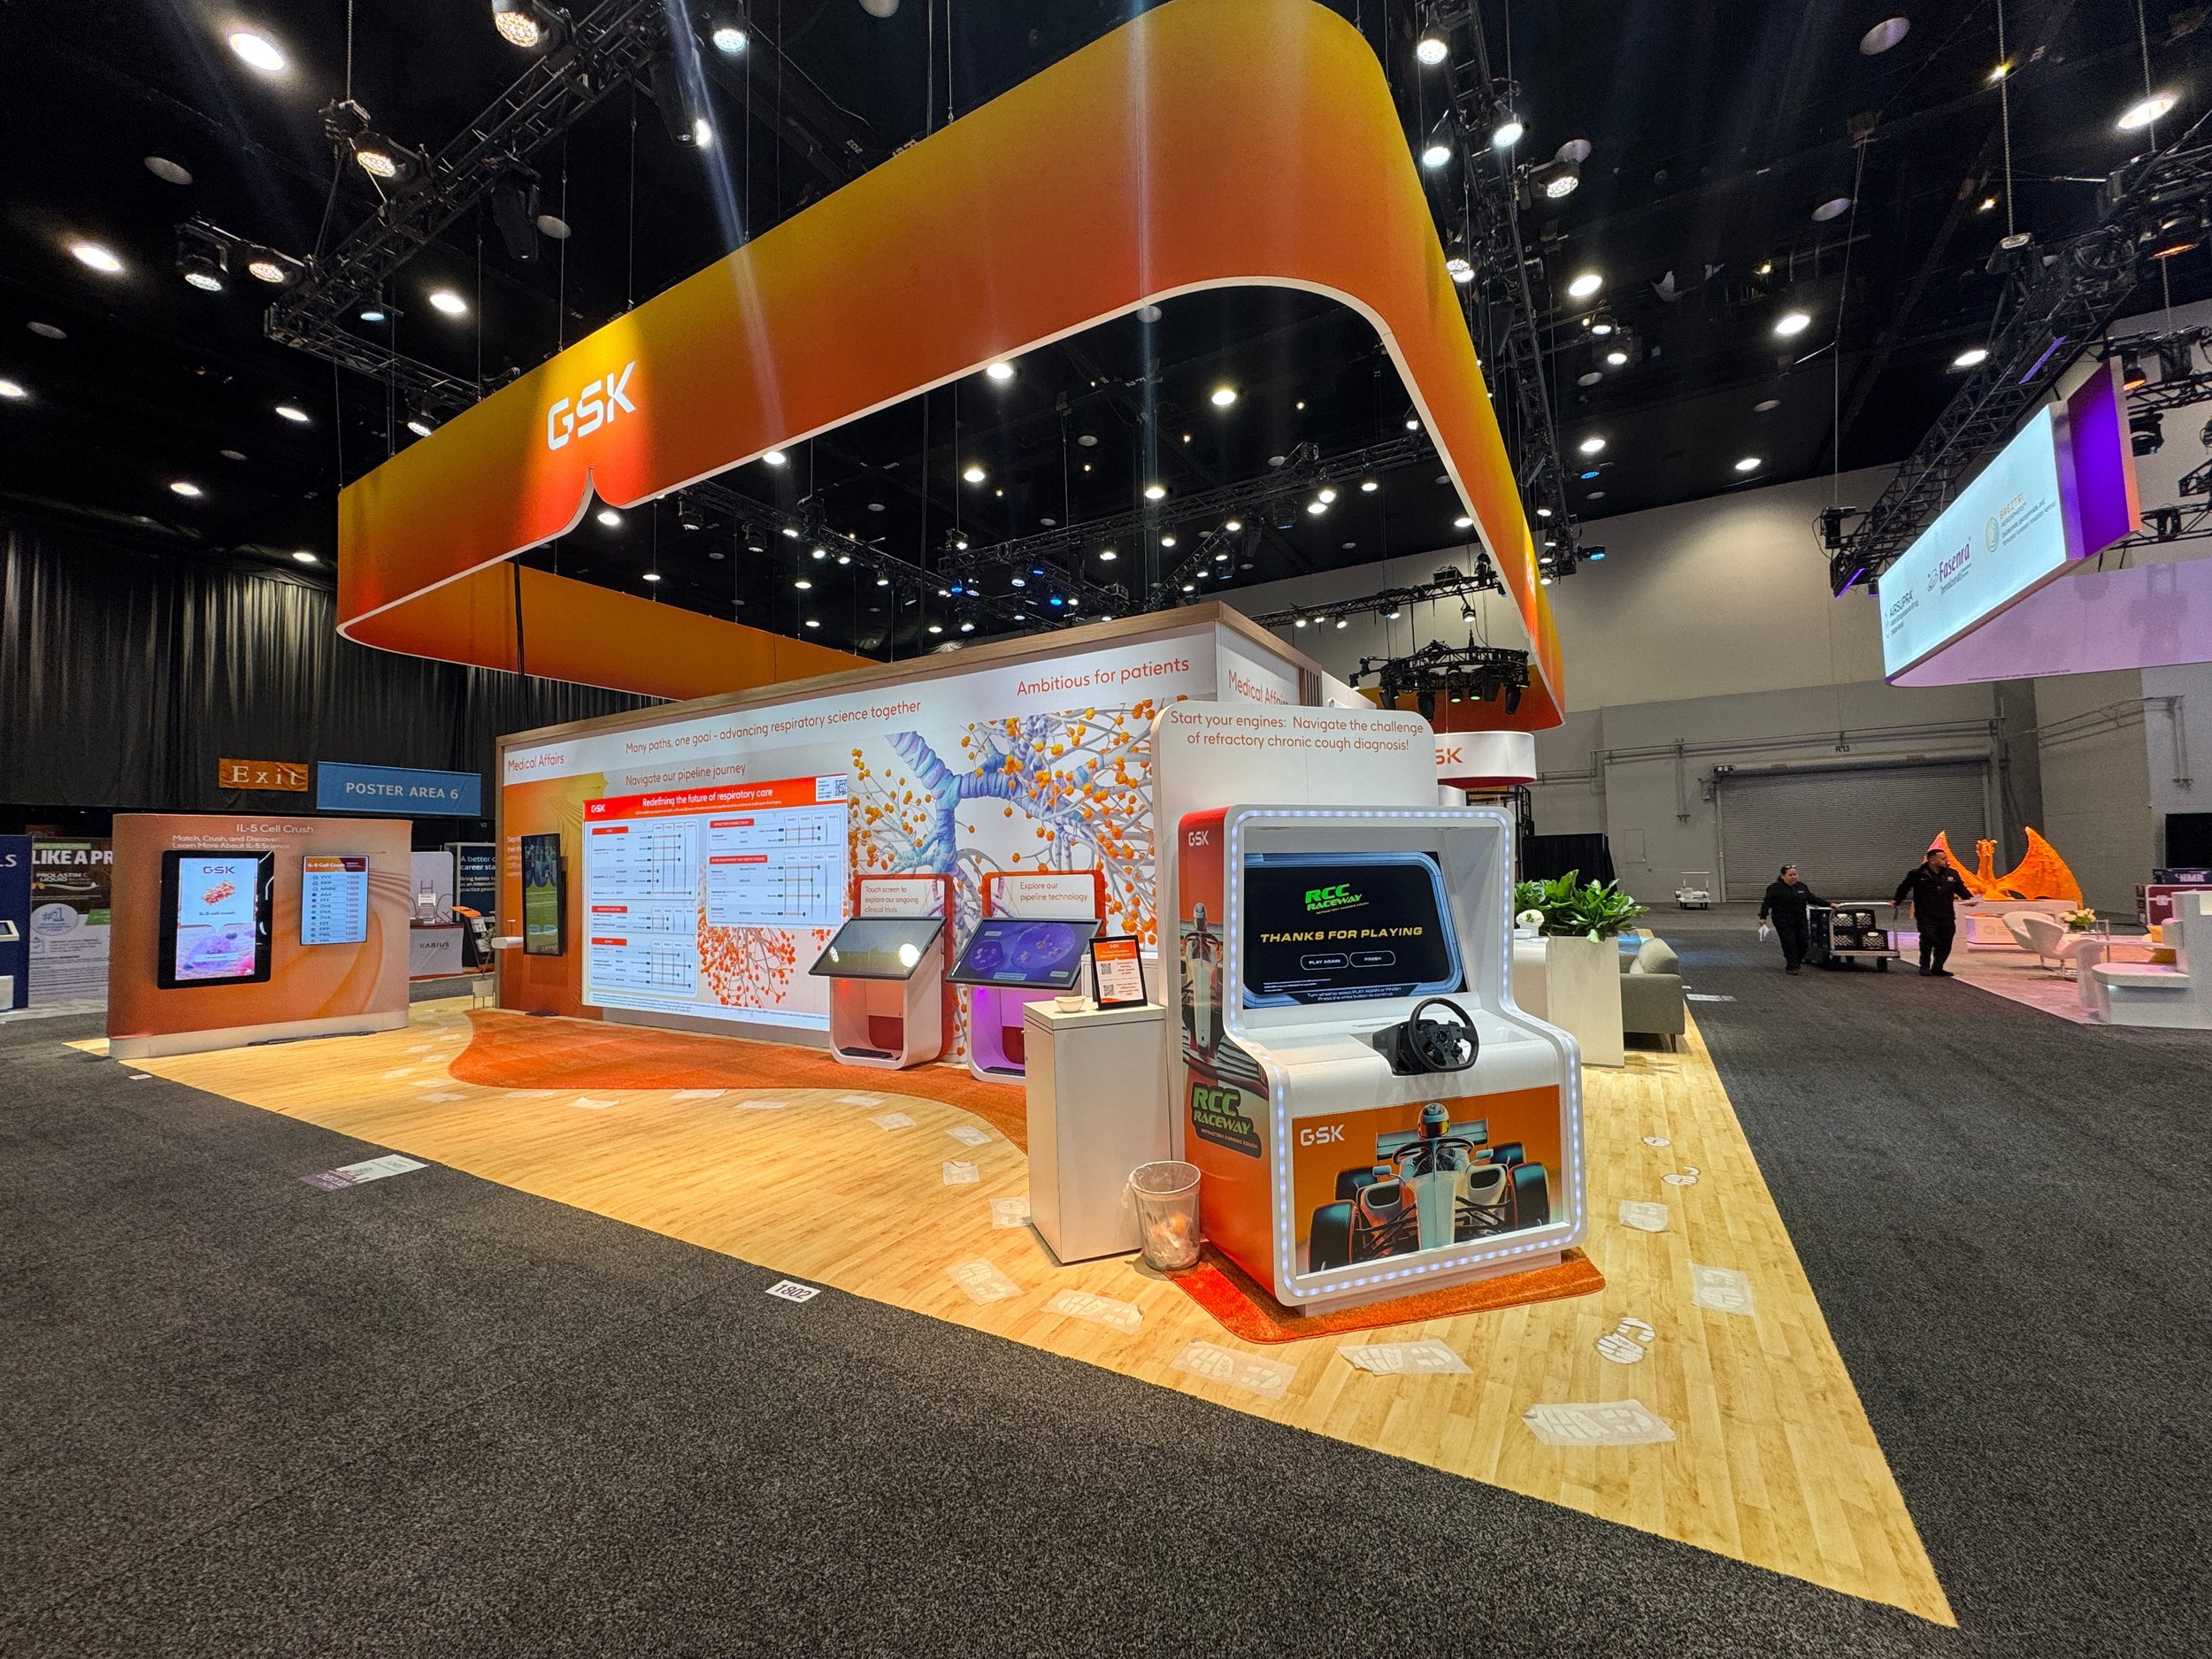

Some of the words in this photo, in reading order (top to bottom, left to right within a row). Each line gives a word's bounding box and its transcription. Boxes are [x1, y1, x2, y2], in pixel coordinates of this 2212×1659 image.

[548, 361, 637, 450] GSK
[1939, 543, 1970, 582] Fasenra
[1017, 673, 1090, 696] Ambitious
[1094, 669, 1116, 684] for
[1120, 657, 1189, 685] patients
[1228, 668, 1263, 703] Medical
[626, 742, 647, 754] Many
[649, 738, 673, 752] paths,
[675, 735, 690, 746] one
[693, 730, 711, 747] goal
[719, 724, 768, 741] advancing
[771, 714, 825, 733] respiratory
[827, 710, 868, 725] science
[871, 700, 920, 721] together
[1171, 710, 1202, 725] Start
[1205, 716, 1233, 728] your
[1236, 715, 1286, 730] engines:
[1293, 716, 1347, 733] Navigate
[1349, 719, 1368, 731] the
[1371, 720, 1424, 736] challenge
[1187, 732, 1201, 744] of
[1204, 733, 1264, 749] refractory
[1267, 734, 1311, 748] chronic
[1315, 737, 1351, 752] cough
[1354, 738, 1409, 753] diagnosis!
[508, 757, 537, 772] Medical
[538, 752, 565, 767] Affairs
[231, 764, 298, 786] Exit
[626, 772, 661, 787] Navigate
[663, 772, 676, 781] our
[678, 765, 710, 784] pipeline
[712, 763, 747, 780] journey
[346, 782, 403, 796] POSTER
[409, 786, 445, 799] AREA
[450, 788, 459, 800] 6
[642, 797, 675, 807] Redefining
[676, 795, 687, 804] the
[688, 794, 708, 803] future
[709, 793, 717, 802] of
[718, 790, 755, 802] respiratory
[591, 804, 606, 813] GSK
[283, 825, 314, 833] Crush
[1188, 830, 1210, 847] GSK
[32, 849, 72, 865] LIKE
[73, 850, 88, 864] A
[1020, 881, 1045, 891] Explore
[1305, 883, 1350, 903] RCC
[1020, 893, 1047, 902] pipeline
[1048, 893, 1087, 902] technology
[1307, 894, 1362, 911] RACEWAY
[1260, 931, 1325, 943] THANKS
[1328, 930, 1357, 940] FOR
[1361, 926, 1423, 939] PLAYING
[1193, 1087, 1239, 1117] RCC
[1194, 1110, 1250, 1135] RACEWAY
[1300, 1124, 1346, 1147] GSK
[775, 1284, 812, 1299] 1802
